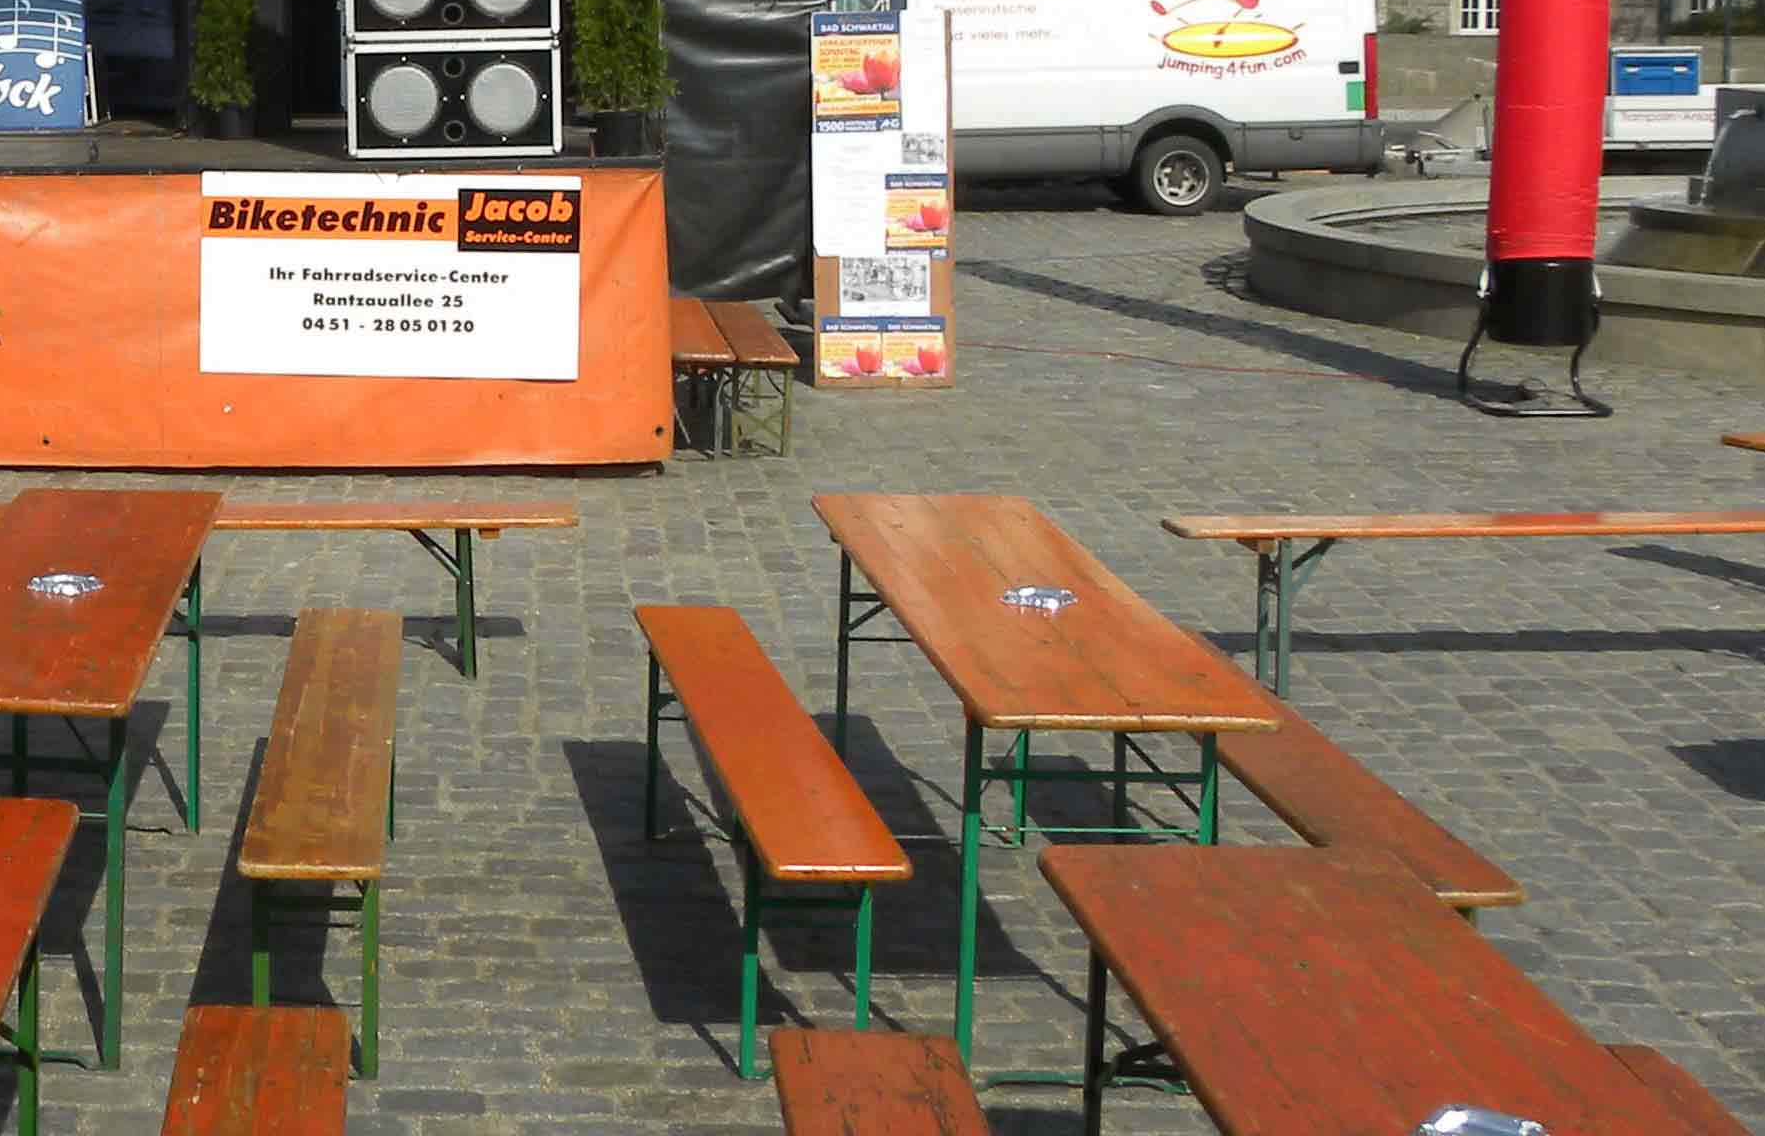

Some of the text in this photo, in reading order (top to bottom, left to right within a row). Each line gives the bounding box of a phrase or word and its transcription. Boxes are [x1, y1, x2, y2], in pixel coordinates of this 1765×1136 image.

[820, 22, 895, 33] BAD SCHWARTAU
[208, 191, 574, 234] Biketechnic Jacob
[463, 230, 573, 245] Service-Center
[269, 267, 509, 284] Ihr Fahrradservice-Center
[313, 292, 463, 309] Rantzauallee 25
